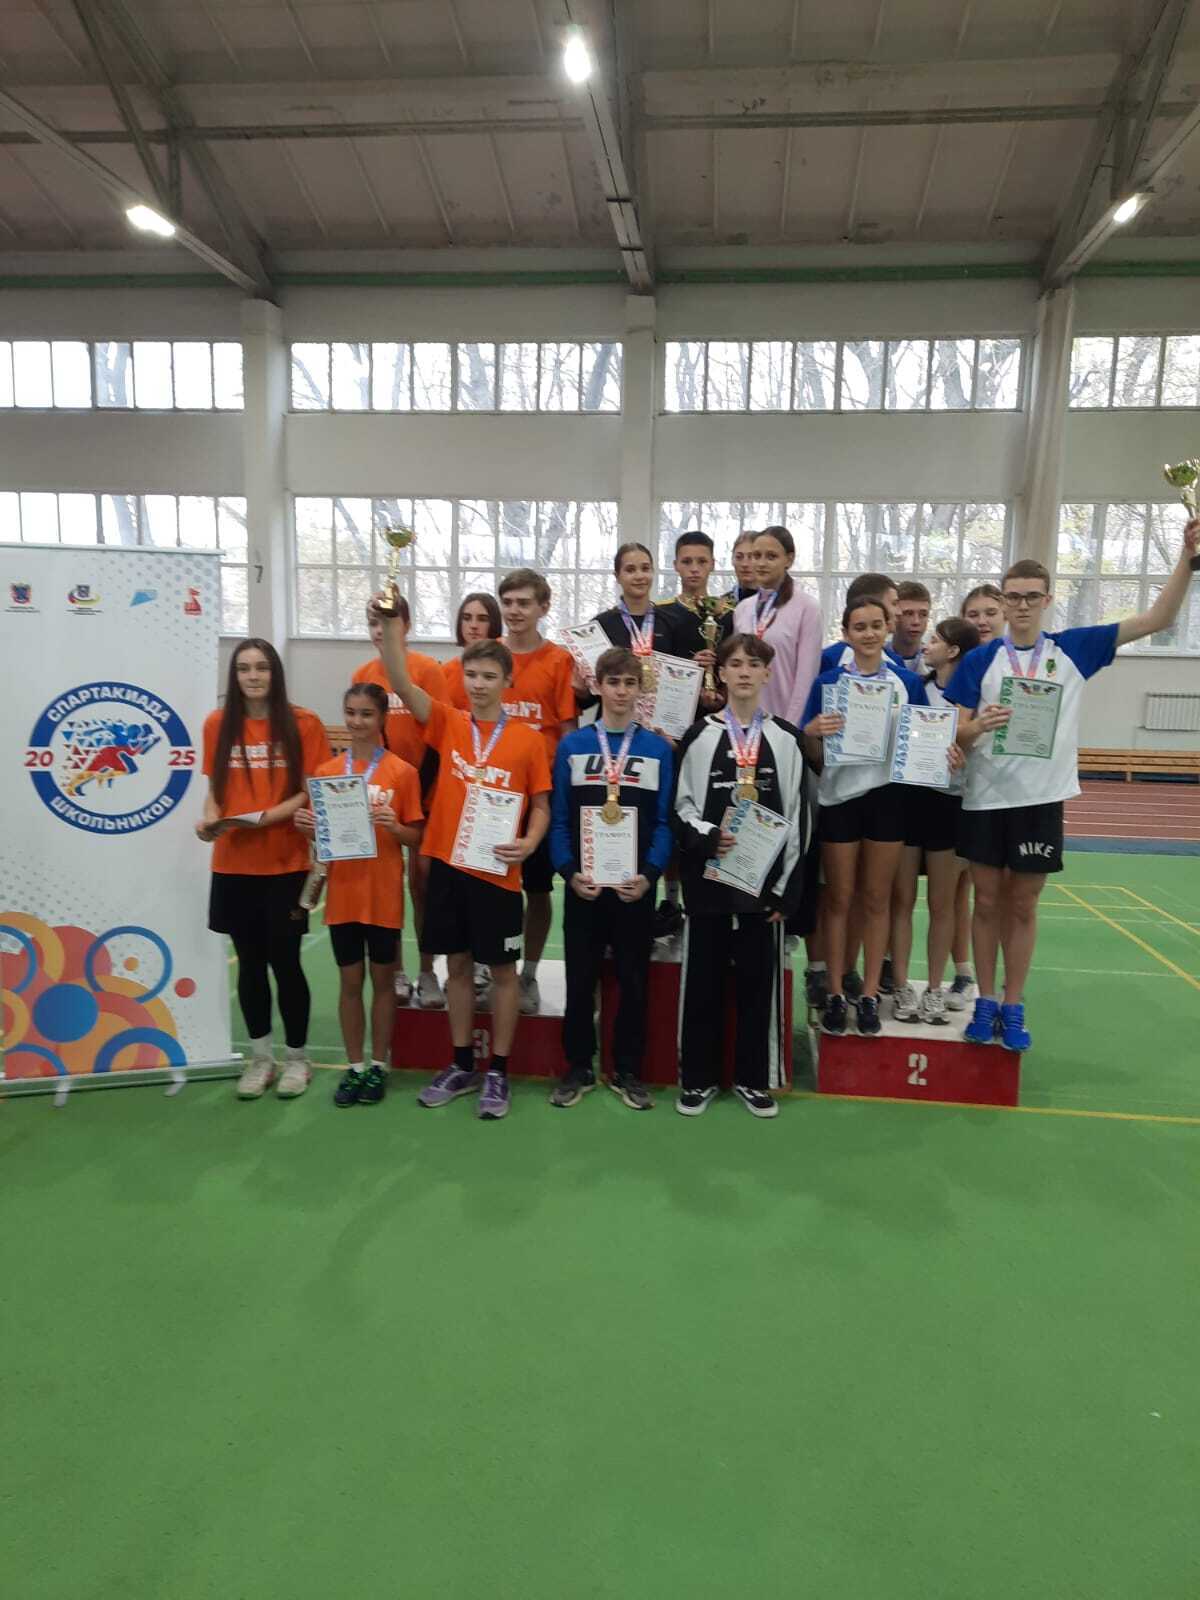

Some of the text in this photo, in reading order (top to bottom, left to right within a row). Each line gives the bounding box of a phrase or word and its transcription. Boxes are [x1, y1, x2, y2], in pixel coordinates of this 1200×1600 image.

[46, 686, 171, 723] СПАРТАКИАДА
[24, 750, 196, 767] 20 25
[50, 795, 175, 830] ШКОЛЬНИКОВ
[1019, 841, 1054, 858] NIKE
[472, 1029, 489, 1058] 3
[907, 1053, 928, 1085] 2
